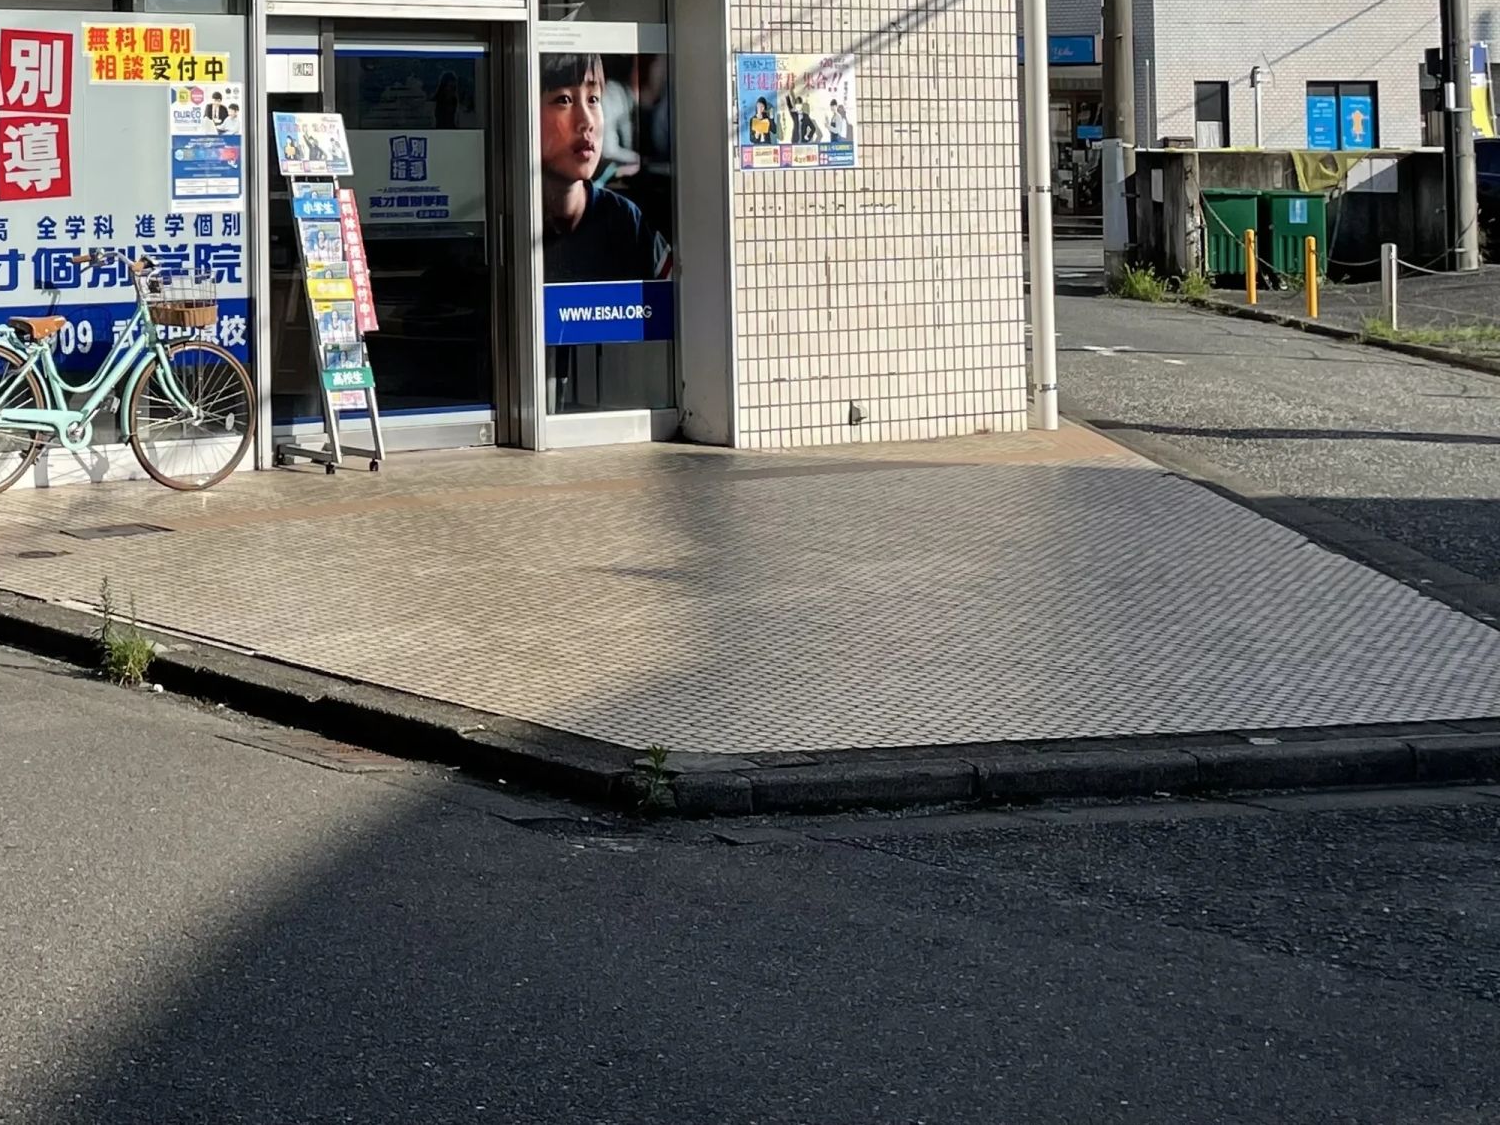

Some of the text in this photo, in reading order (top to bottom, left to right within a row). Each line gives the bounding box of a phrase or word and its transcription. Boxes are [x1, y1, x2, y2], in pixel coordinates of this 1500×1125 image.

[88, 27, 190, 53] 無料個別
[95, 55, 223, 81] 相談受付中
[303, 200, 335, 215] 小学生
[36, 215, 114, 241] 全学科
[134, 212, 241, 240] 進学個別
[559, 304, 653, 322] WWW.EISAI.ORG
[332, 370, 365, 386] 高校生
